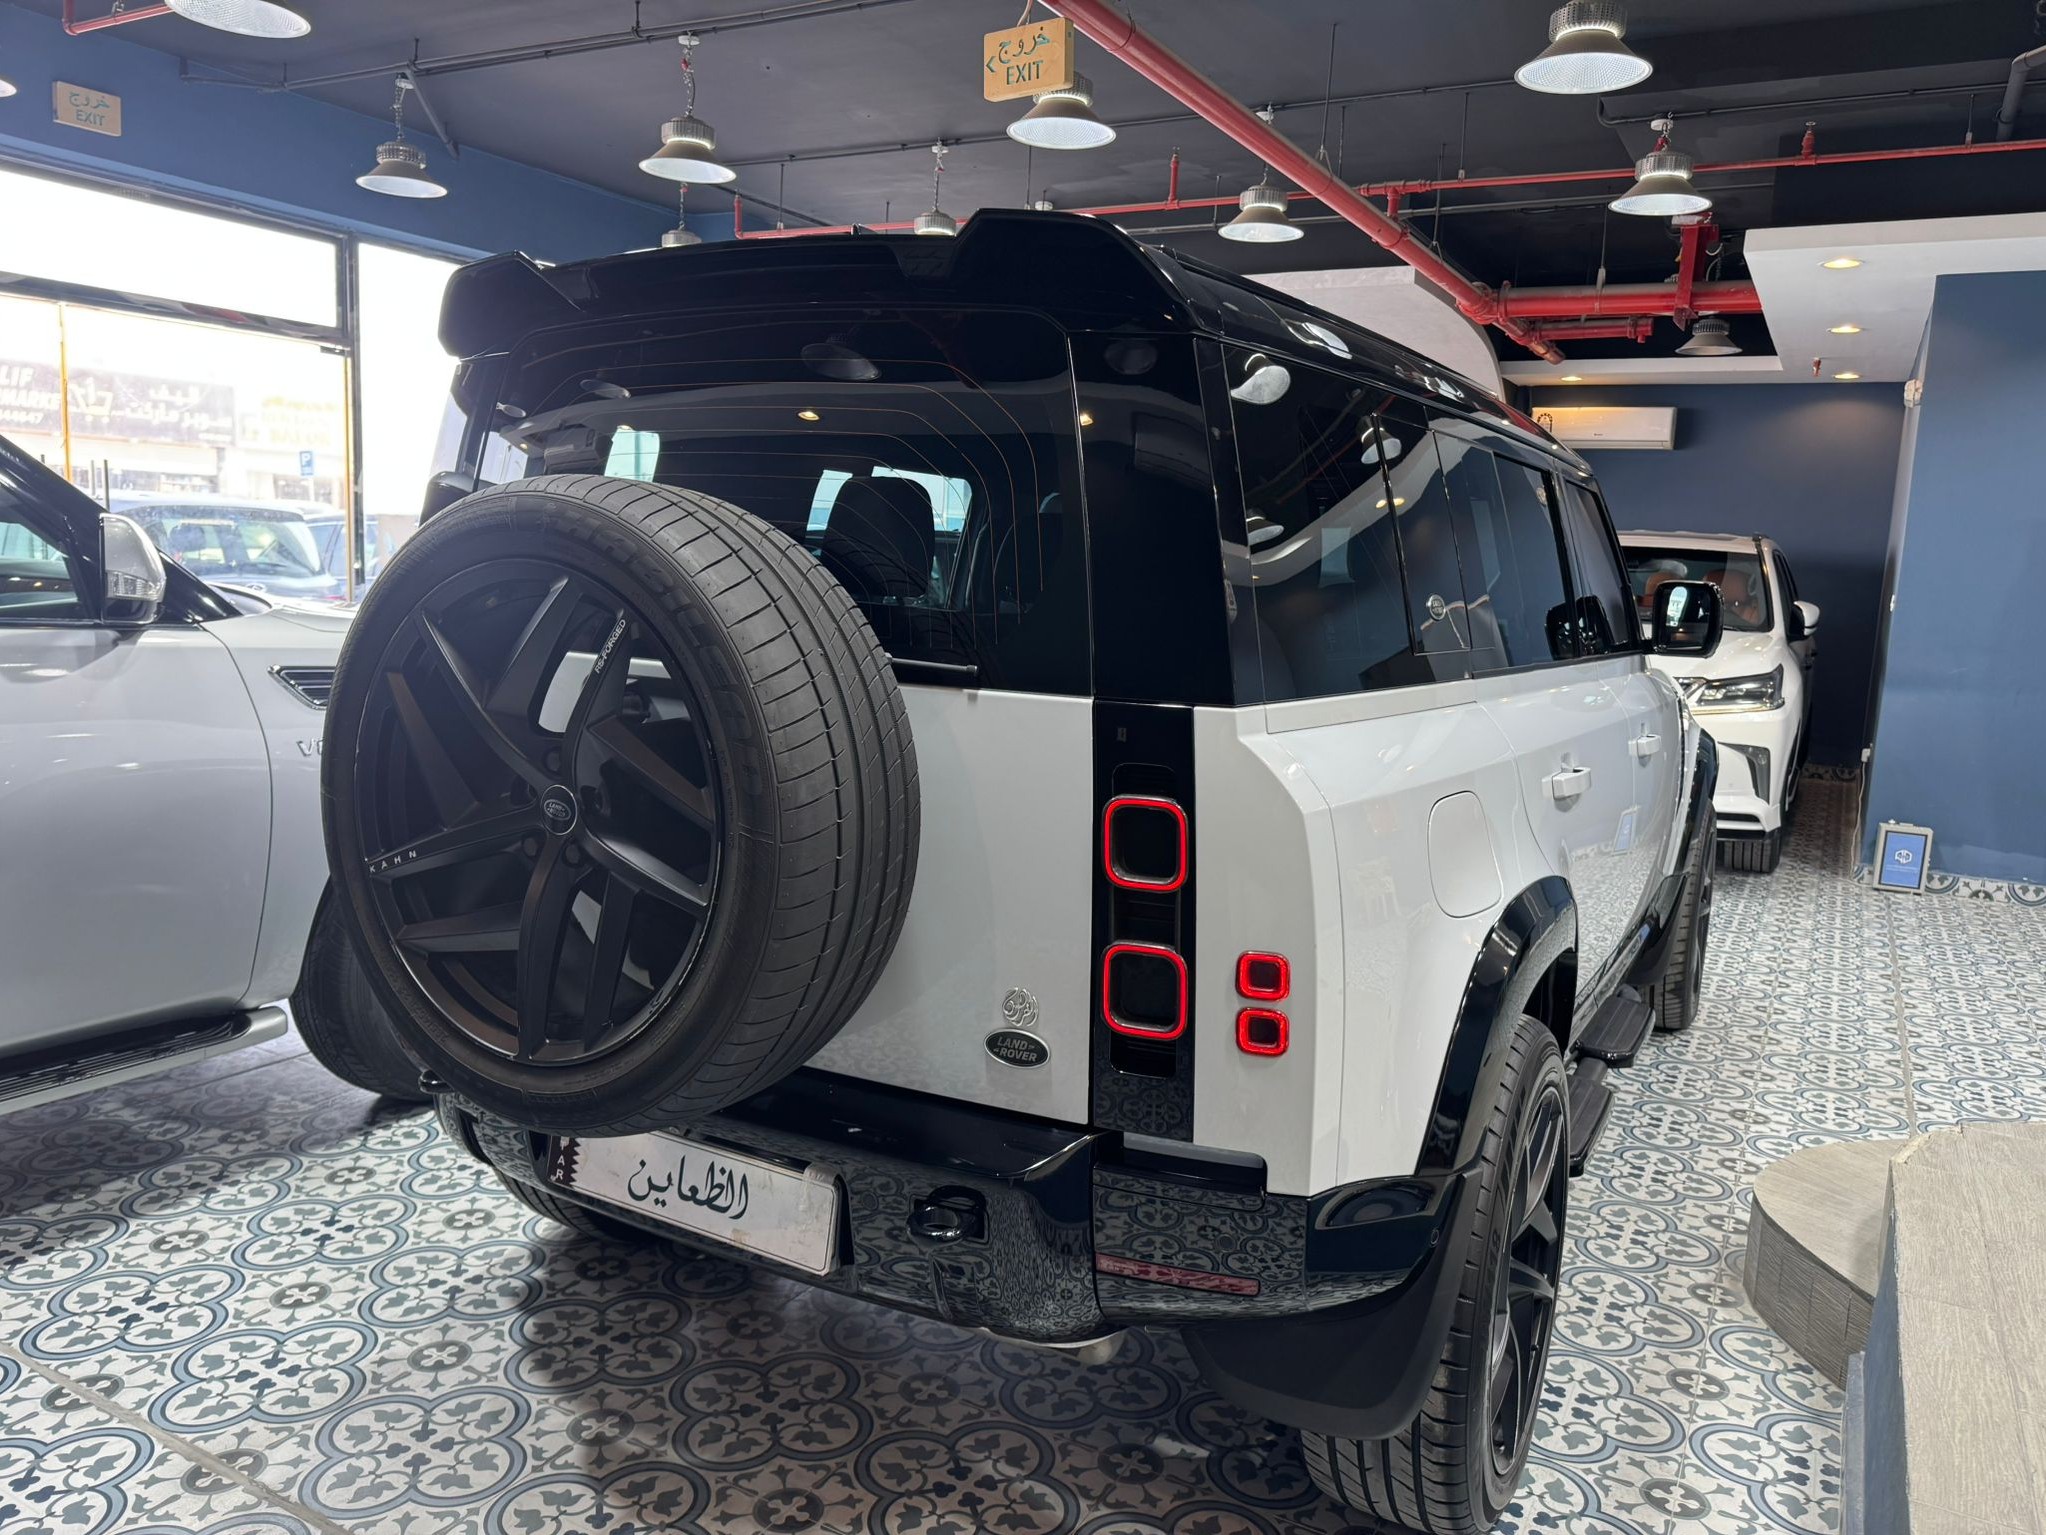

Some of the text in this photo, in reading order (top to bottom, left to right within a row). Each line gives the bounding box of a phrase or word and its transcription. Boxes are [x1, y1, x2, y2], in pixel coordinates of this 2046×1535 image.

[998, 26, 1050, 64] خروج
[1006, 60, 1043, 85] EXIT
[69, 92, 110, 109] خروج
[76, 109, 105, 126] EXIT
[301, 453, 311, 465] P
[369, 850, 417, 873] KAHN
[997, 1036, 1028, 1050] LAND
[1000, 1047, 1037, 1062] ROVER
[627, 1155, 749, 1219] الظعاين
